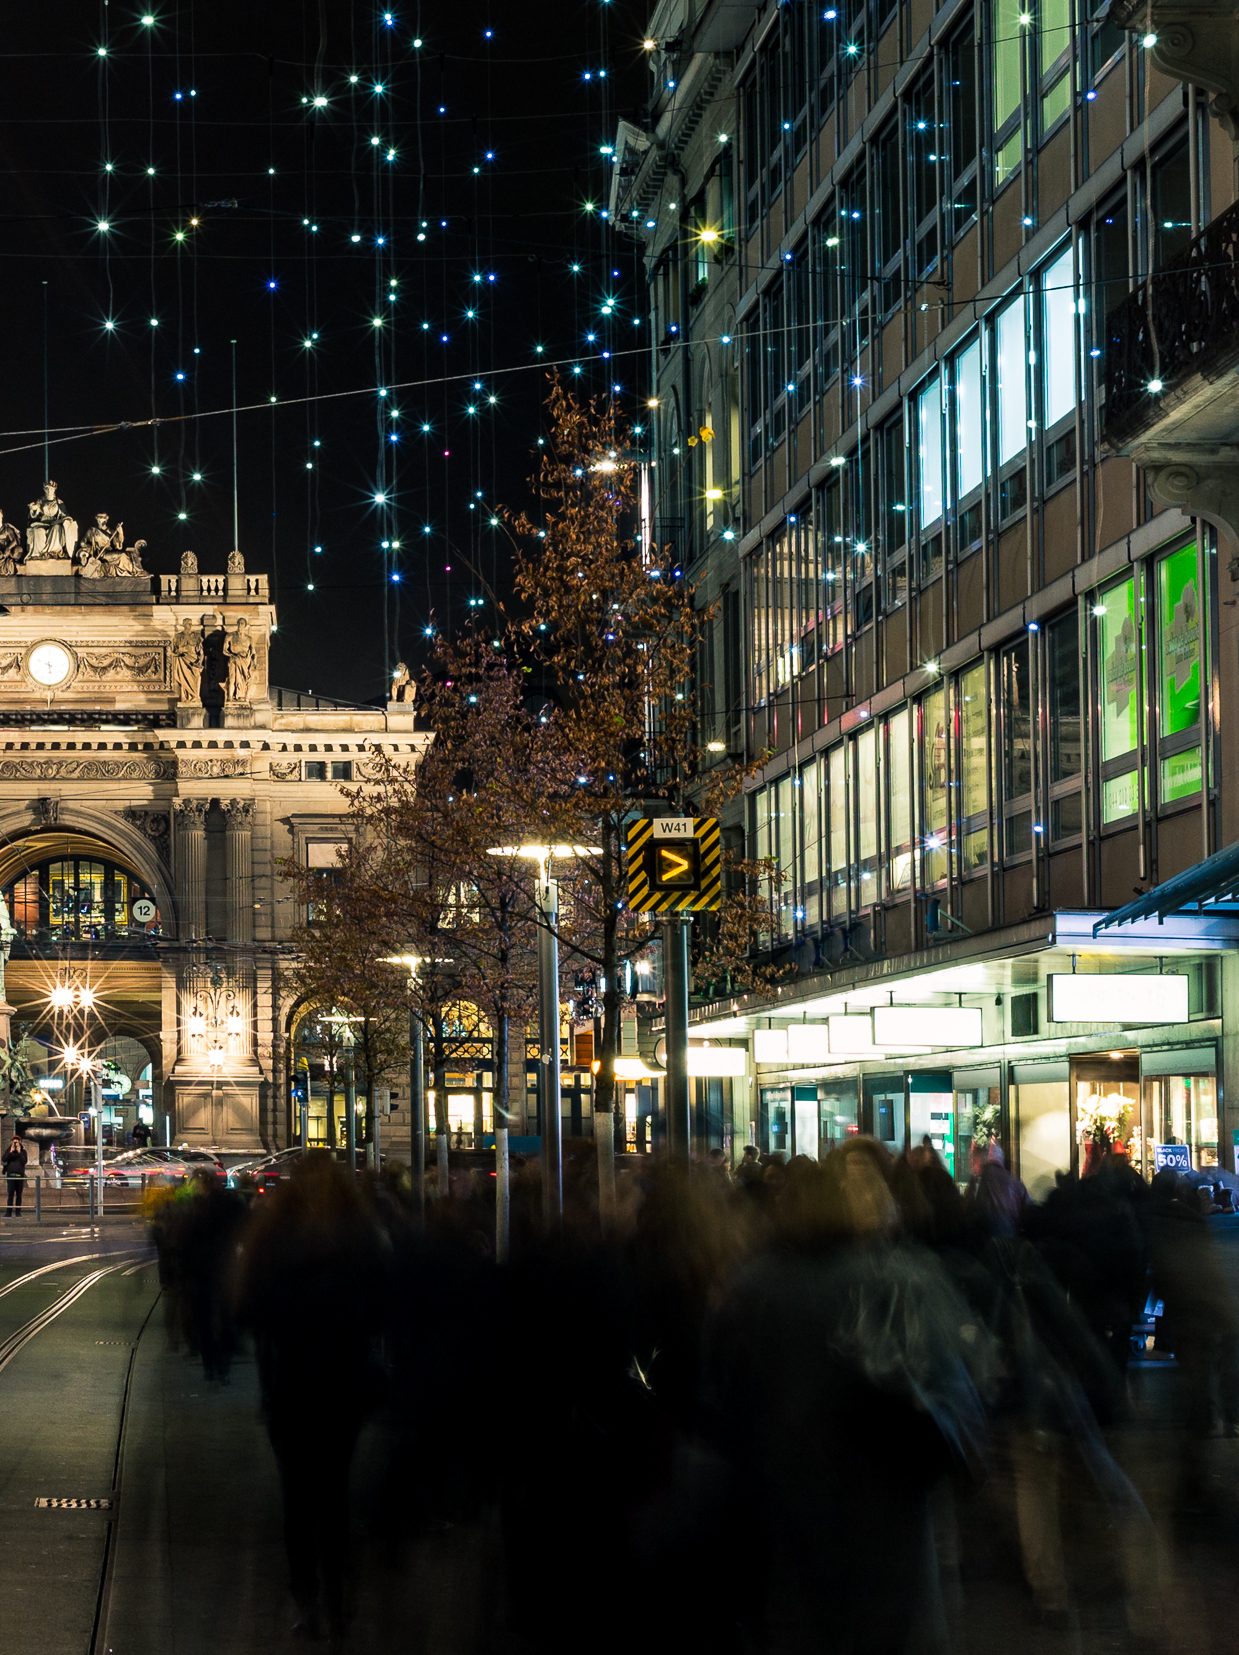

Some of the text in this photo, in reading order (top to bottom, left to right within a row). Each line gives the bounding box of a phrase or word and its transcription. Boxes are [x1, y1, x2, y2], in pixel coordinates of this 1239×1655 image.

[661, 822, 687, 833] W41
[137, 905, 151, 916] 12
[1158, 1153, 1187, 1167] 50%
